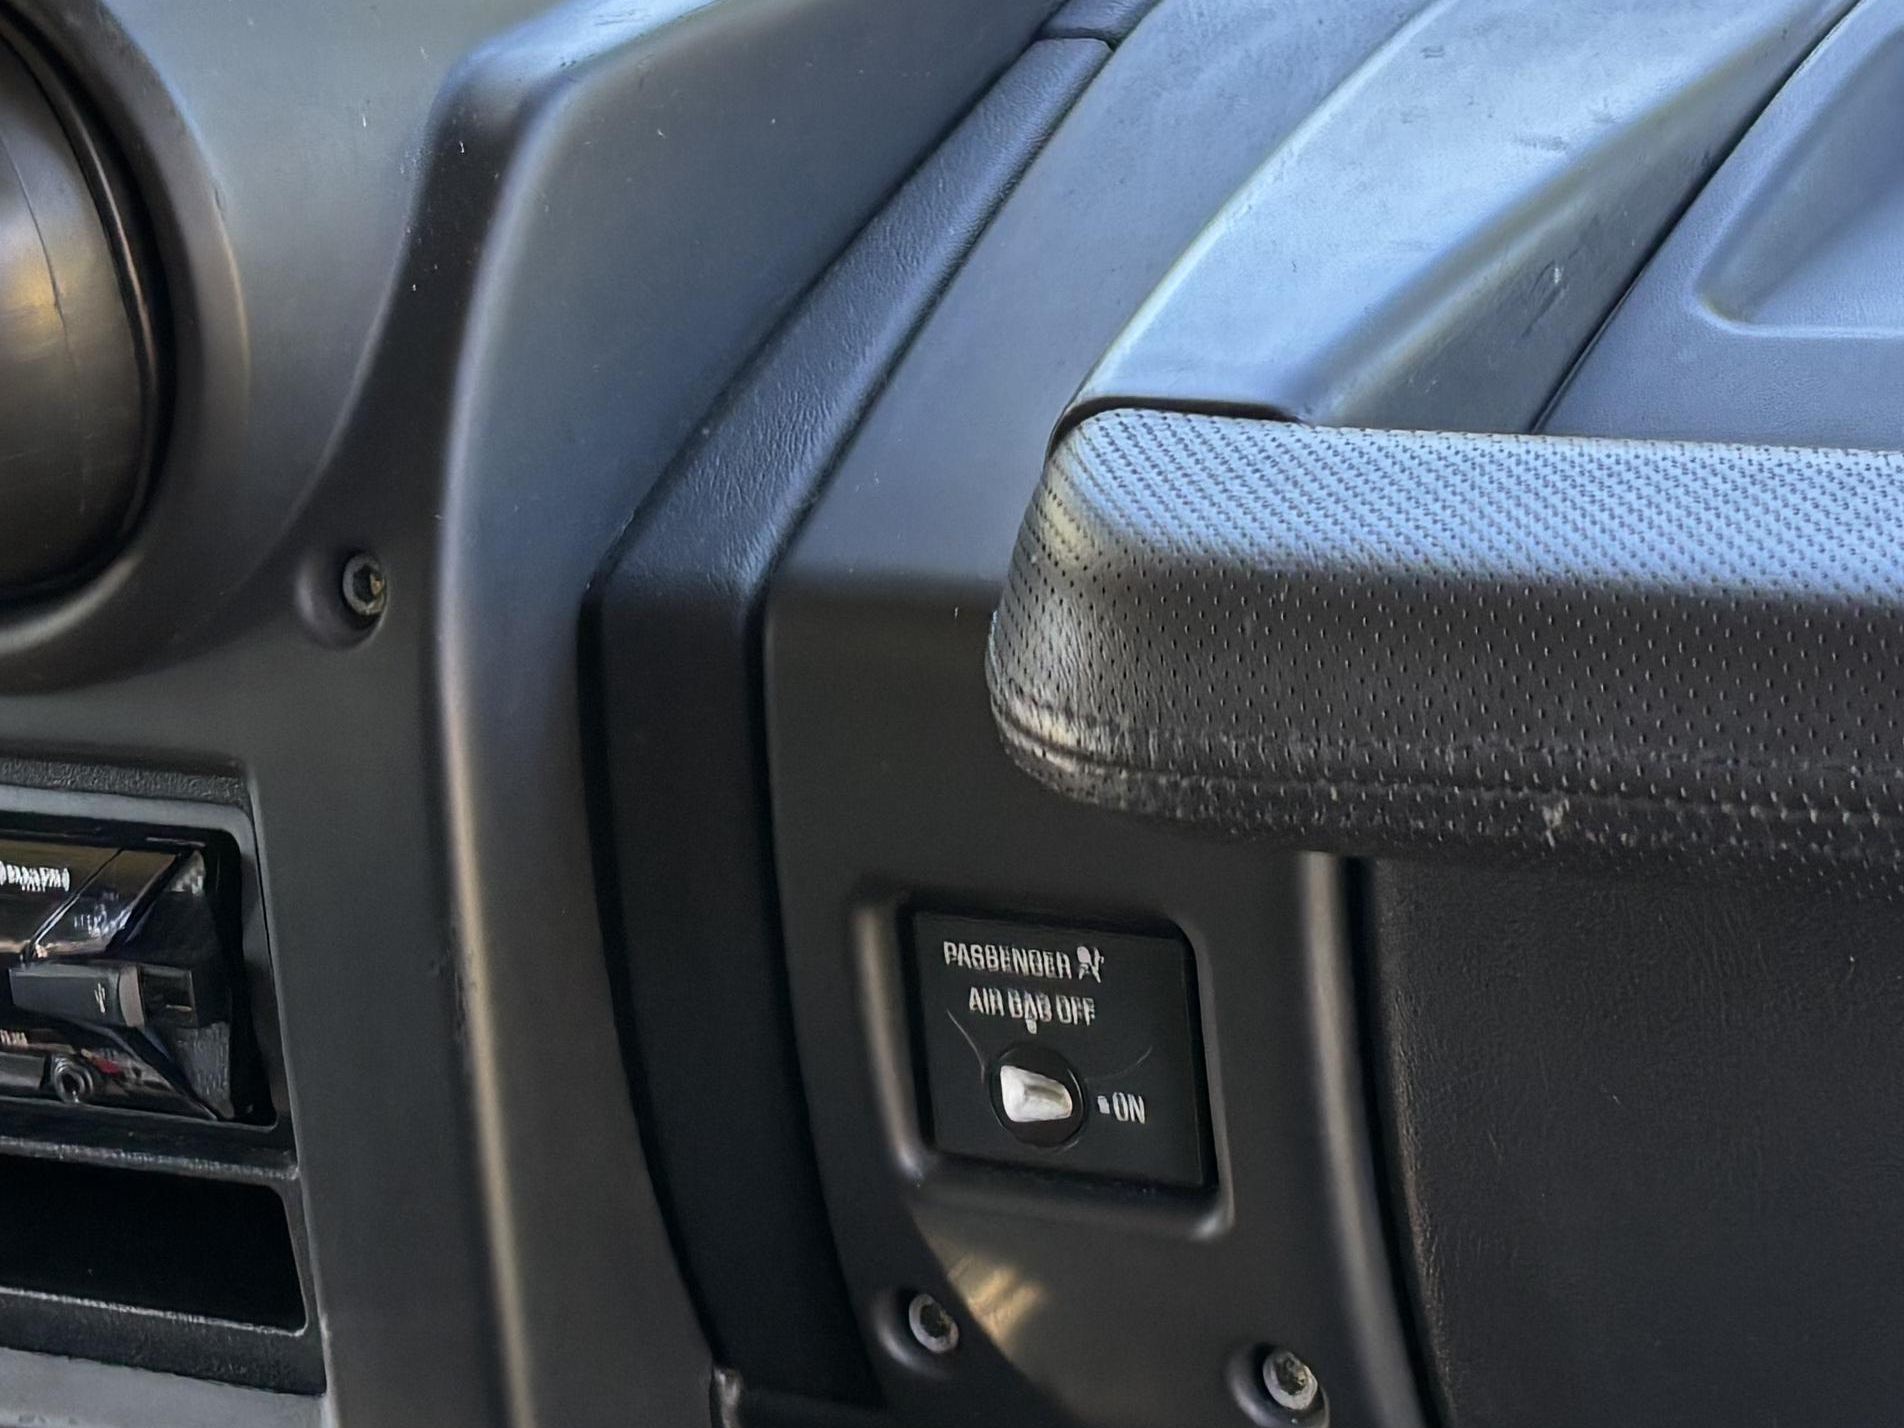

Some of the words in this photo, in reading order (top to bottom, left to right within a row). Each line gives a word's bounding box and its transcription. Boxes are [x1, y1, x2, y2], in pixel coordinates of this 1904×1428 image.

[942, 940, 1073, 980] PASSENGER
[968, 986, 1005, 1018] AIR
[1007, 988, 1053, 1023] BAG
[1055, 993, 1097, 1027] OFF
[1112, 1091, 1147, 1126] ON
